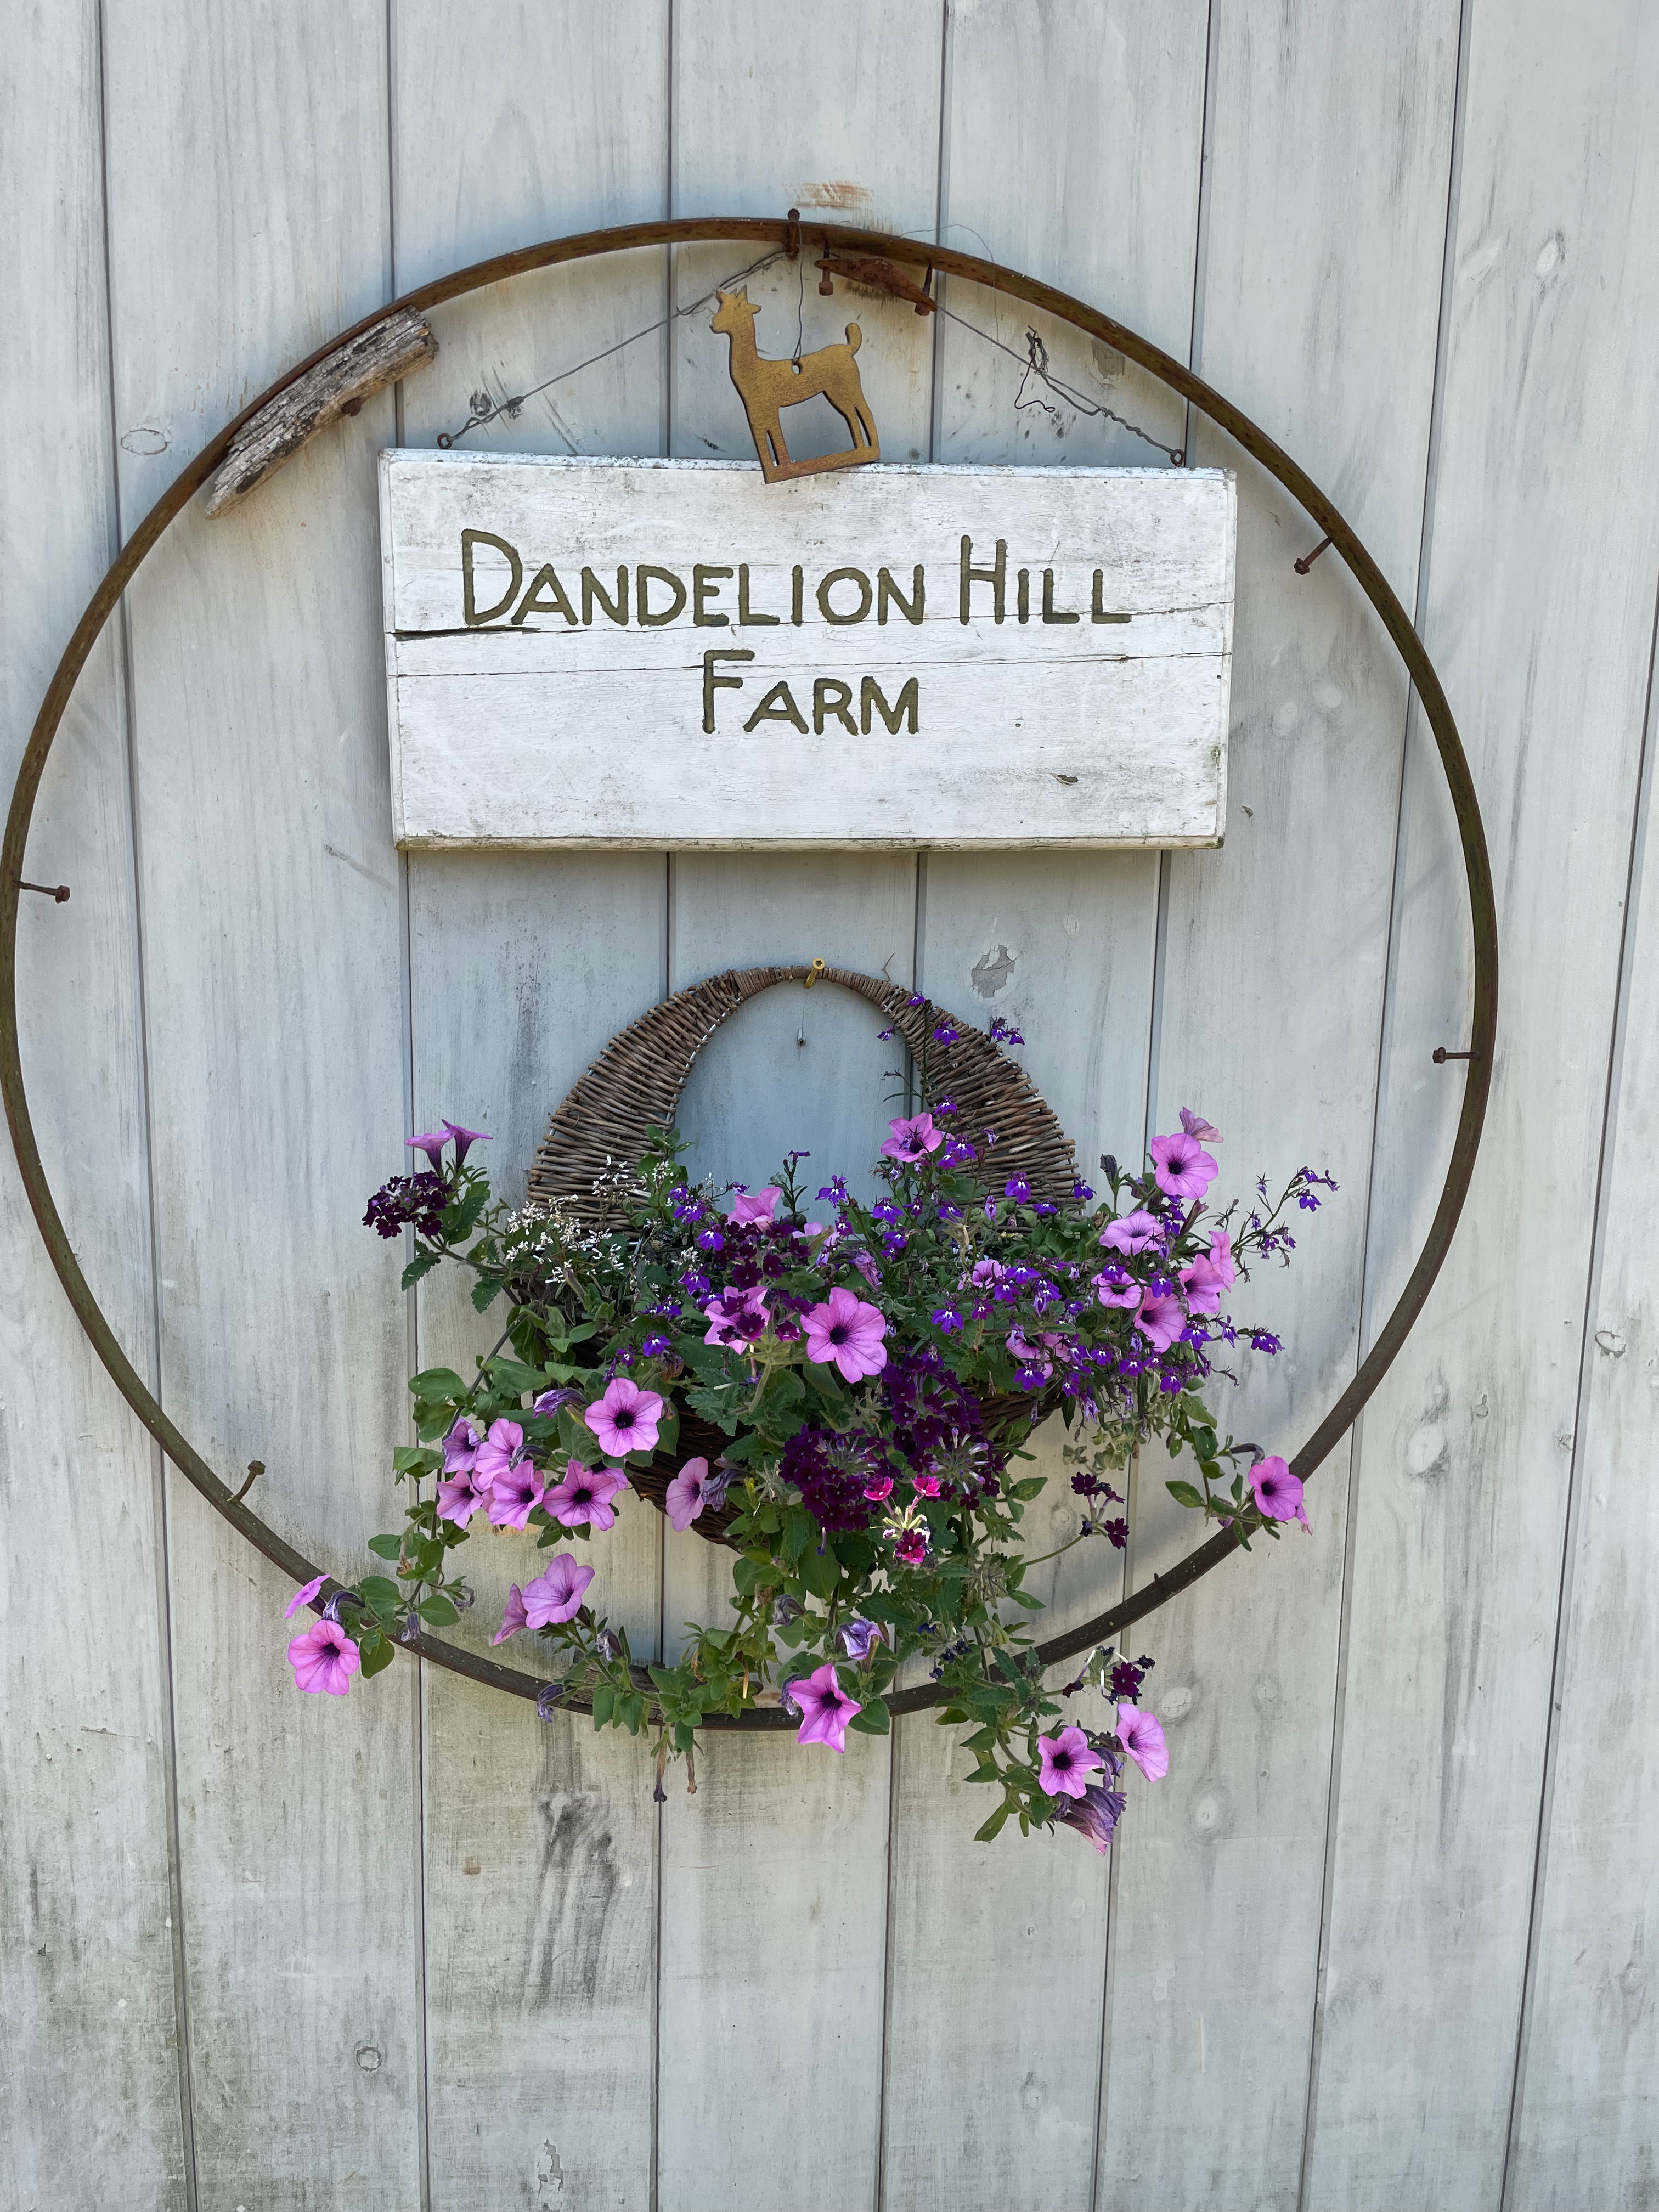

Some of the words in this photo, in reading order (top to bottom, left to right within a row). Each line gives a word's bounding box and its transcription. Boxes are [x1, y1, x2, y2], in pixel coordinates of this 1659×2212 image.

[460, 528, 926, 627] DANDELION
[960, 535, 1132, 625] HILL
[703, 649, 919, 736] FARM
